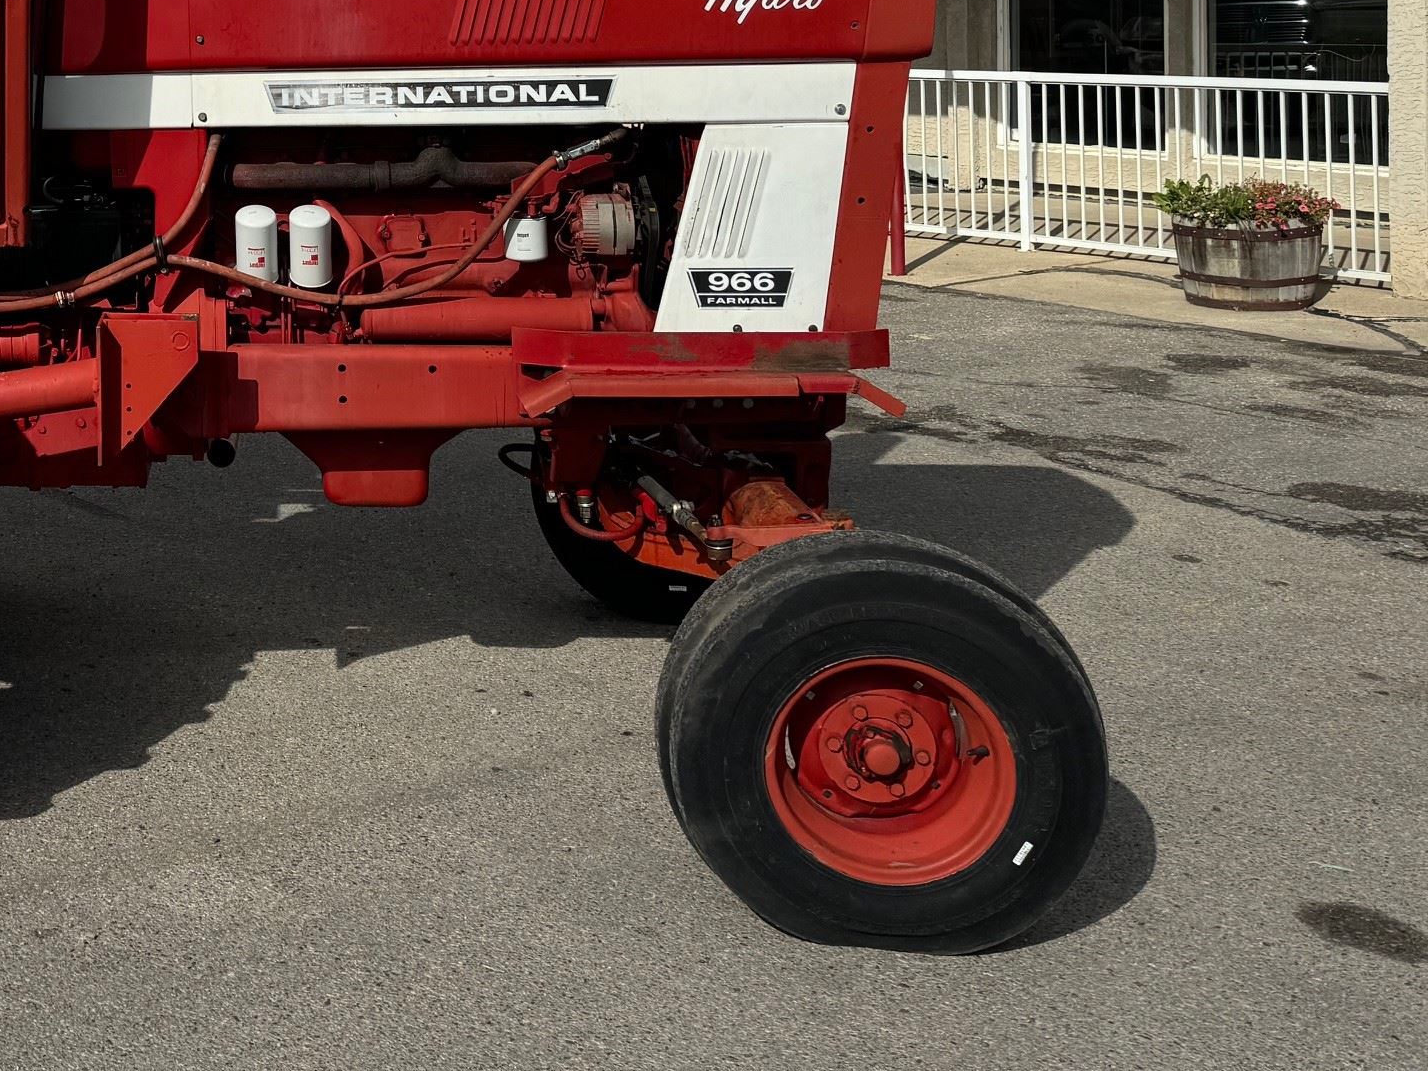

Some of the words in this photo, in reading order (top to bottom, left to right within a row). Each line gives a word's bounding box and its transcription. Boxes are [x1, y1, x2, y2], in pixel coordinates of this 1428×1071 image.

[280, 82, 600, 107] INTERNATIONAL
[708, 272, 775, 292] 966
[707, 297, 777, 305] FARMALL
